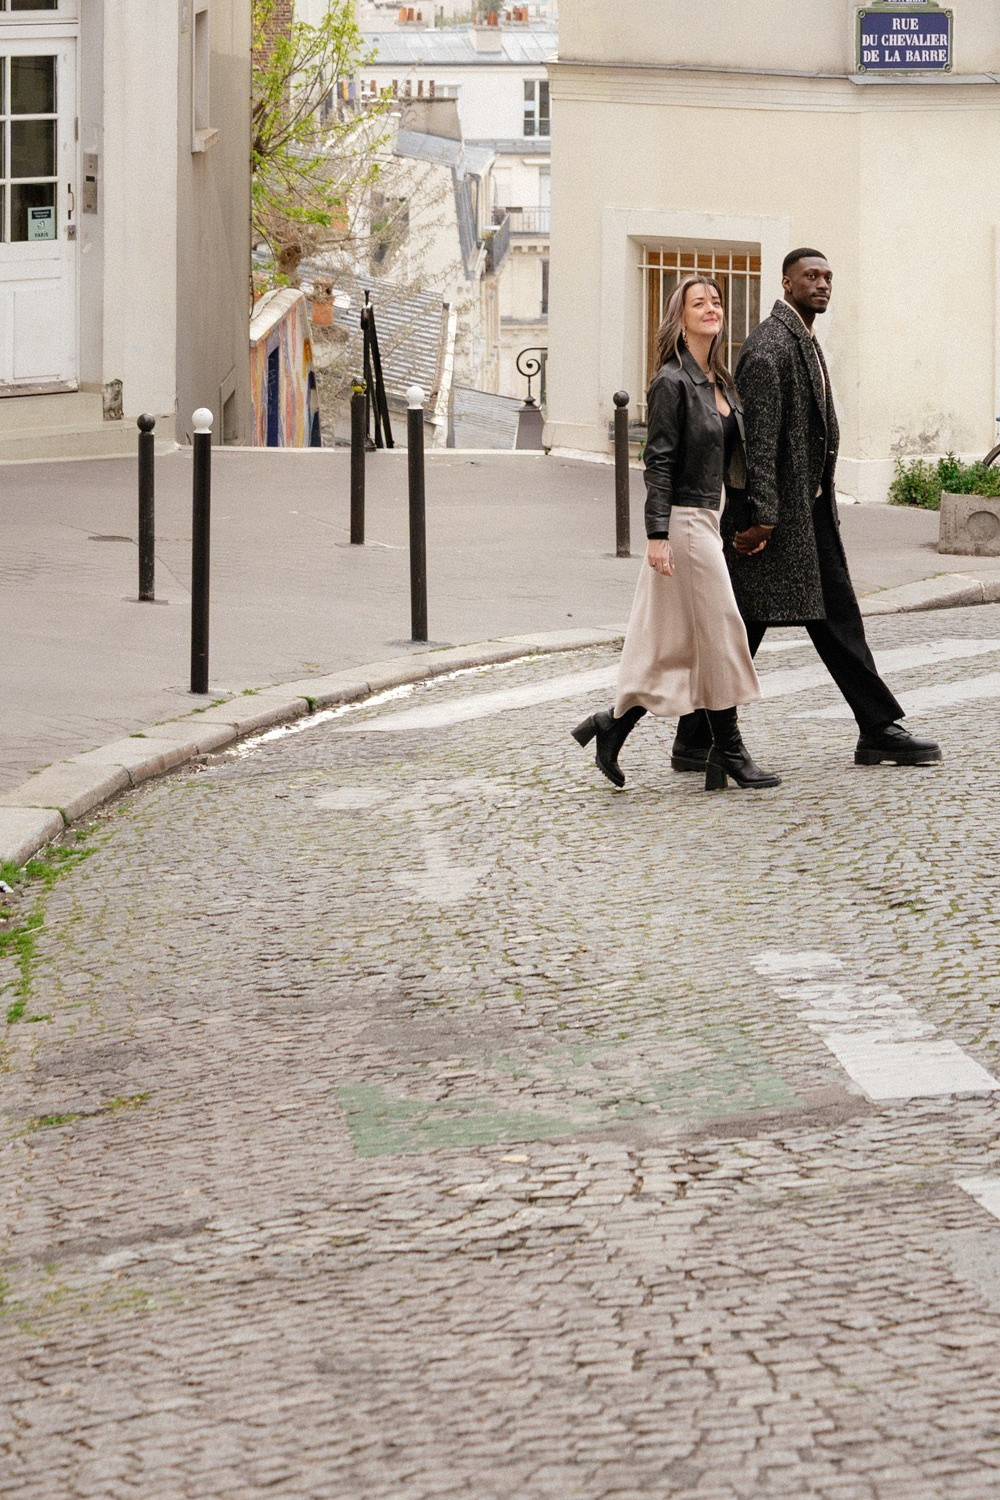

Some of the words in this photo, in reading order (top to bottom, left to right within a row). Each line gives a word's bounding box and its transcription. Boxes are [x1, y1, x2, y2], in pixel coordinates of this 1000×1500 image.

[892, 17, 919, 30] RUE
[862, 34, 878, 46] DU
[881, 33, 948, 46] CHEVALIER
[863, 50, 880, 62] DE
[885, 50, 901, 62] LA
[905, 49, 947, 62] BARRE
